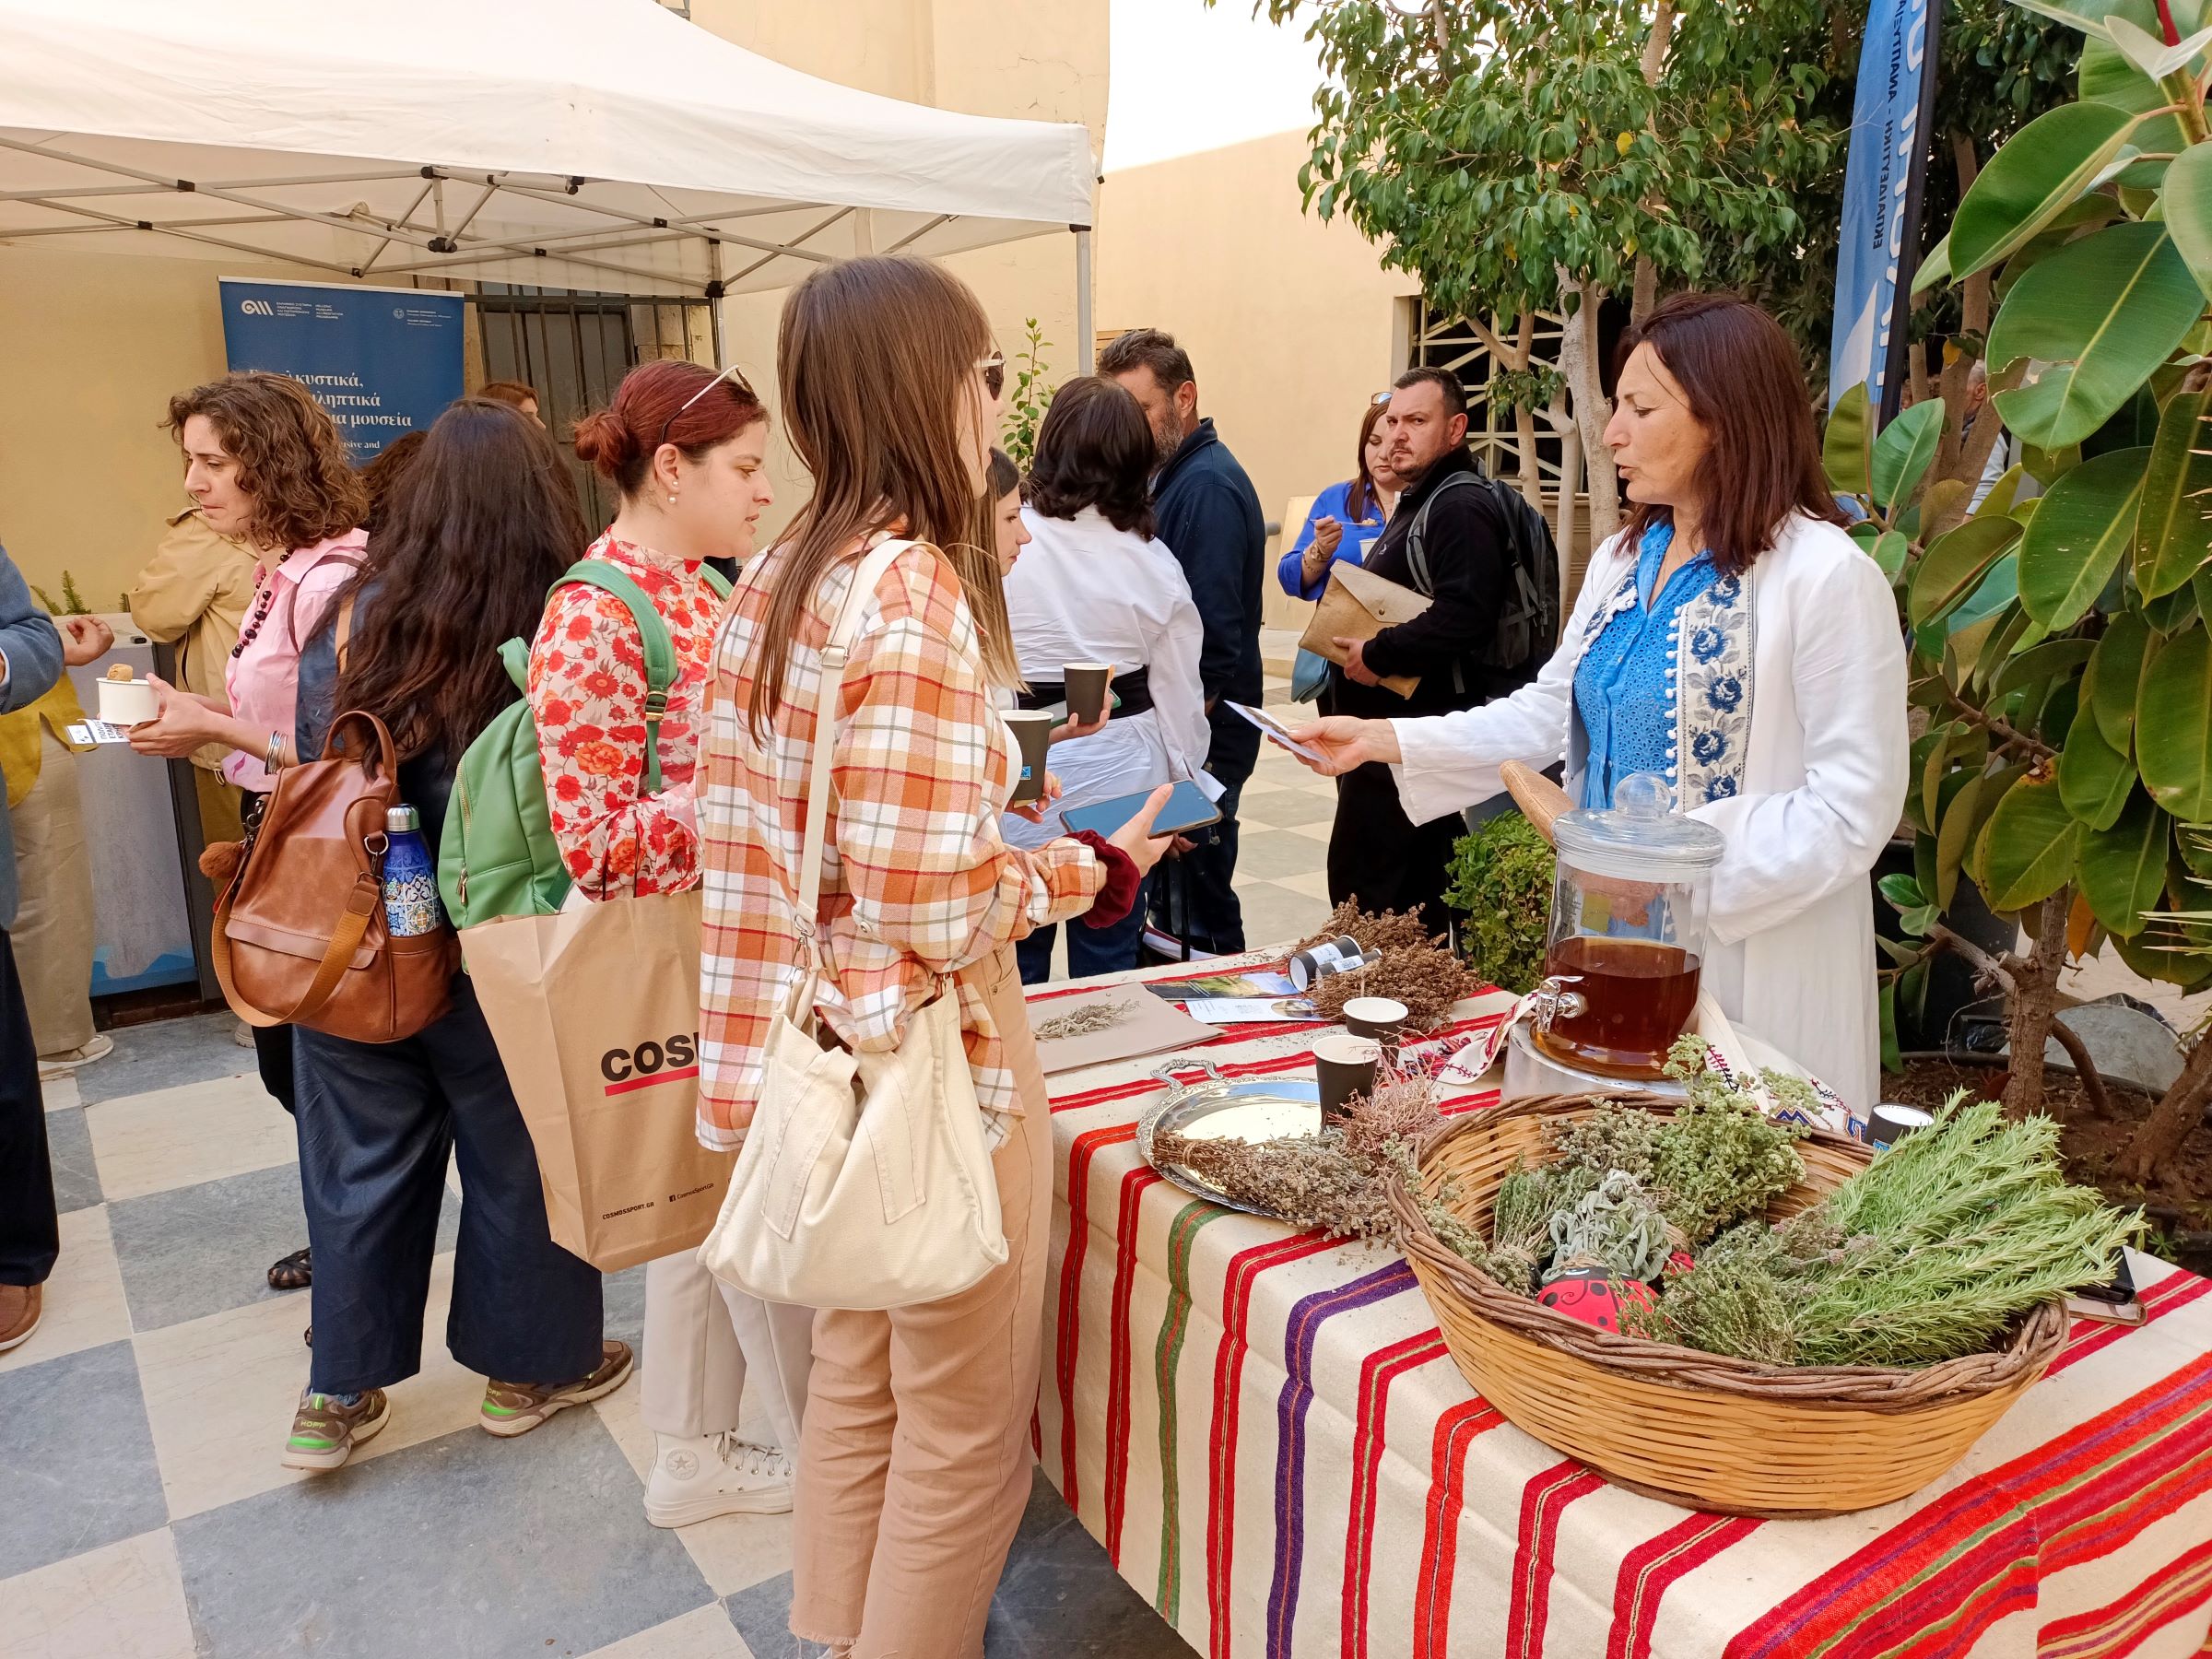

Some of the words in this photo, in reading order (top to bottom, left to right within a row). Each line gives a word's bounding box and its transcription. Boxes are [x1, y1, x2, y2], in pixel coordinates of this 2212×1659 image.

[350, 411, 412, 428] μουσεία
[364, 441, 380, 449] and
[601, 1031, 699, 1082] COS
